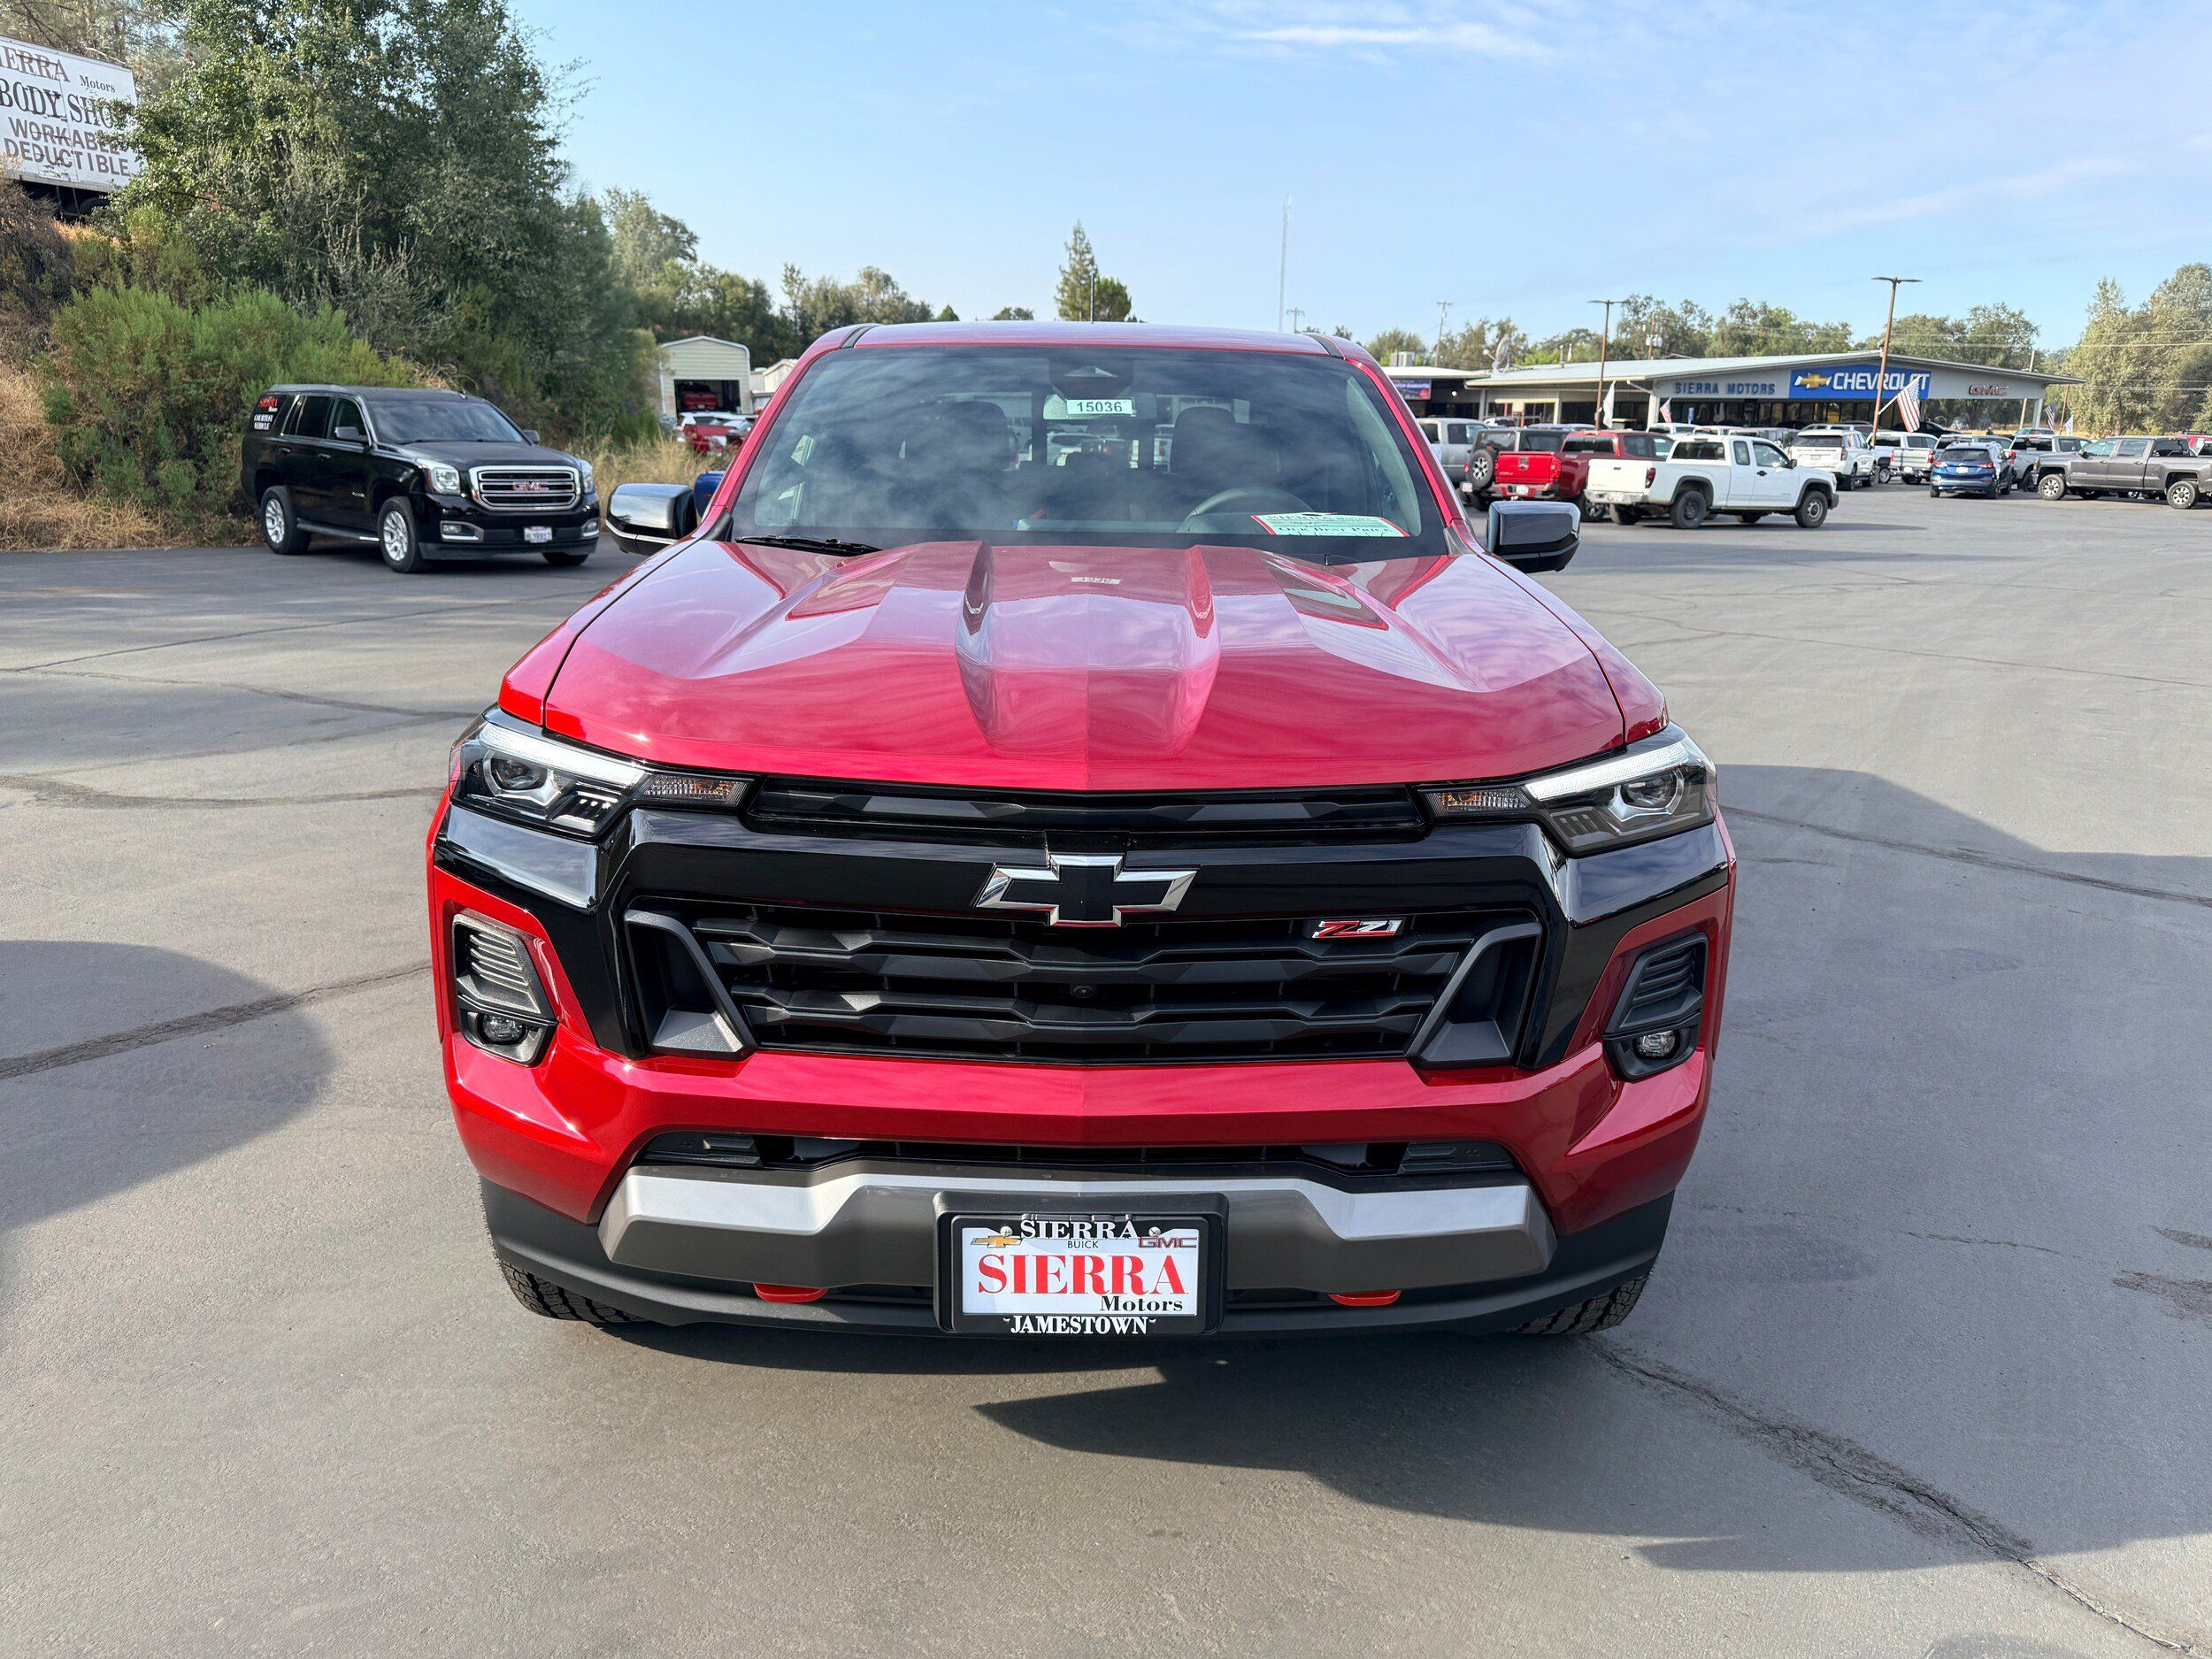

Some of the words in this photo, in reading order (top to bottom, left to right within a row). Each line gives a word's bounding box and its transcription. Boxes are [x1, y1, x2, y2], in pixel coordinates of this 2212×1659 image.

[80, 75, 116, 93] Motors
[0, 78, 65, 119] BODY
[67, 94, 115, 129] SHO
[4, 137, 130, 176] DEDUCTIBLE
[1675, 382, 1719, 395] SIERRA
[1727, 383, 1775, 395] MOTORS
[1969, 384, 2008, 396] GMC
[1077, 401, 1122, 412] 15036
[1312, 920, 1402, 938] Z71
[1020, 1220, 1139, 1239] SIERRA
[1138, 1237, 1197, 1248] GMC
[978, 1255, 1189, 1295] SIERRA
[1100, 1295, 1183, 1312] Motors
[1010, 1316, 1148, 1334] JAMESTOWN
